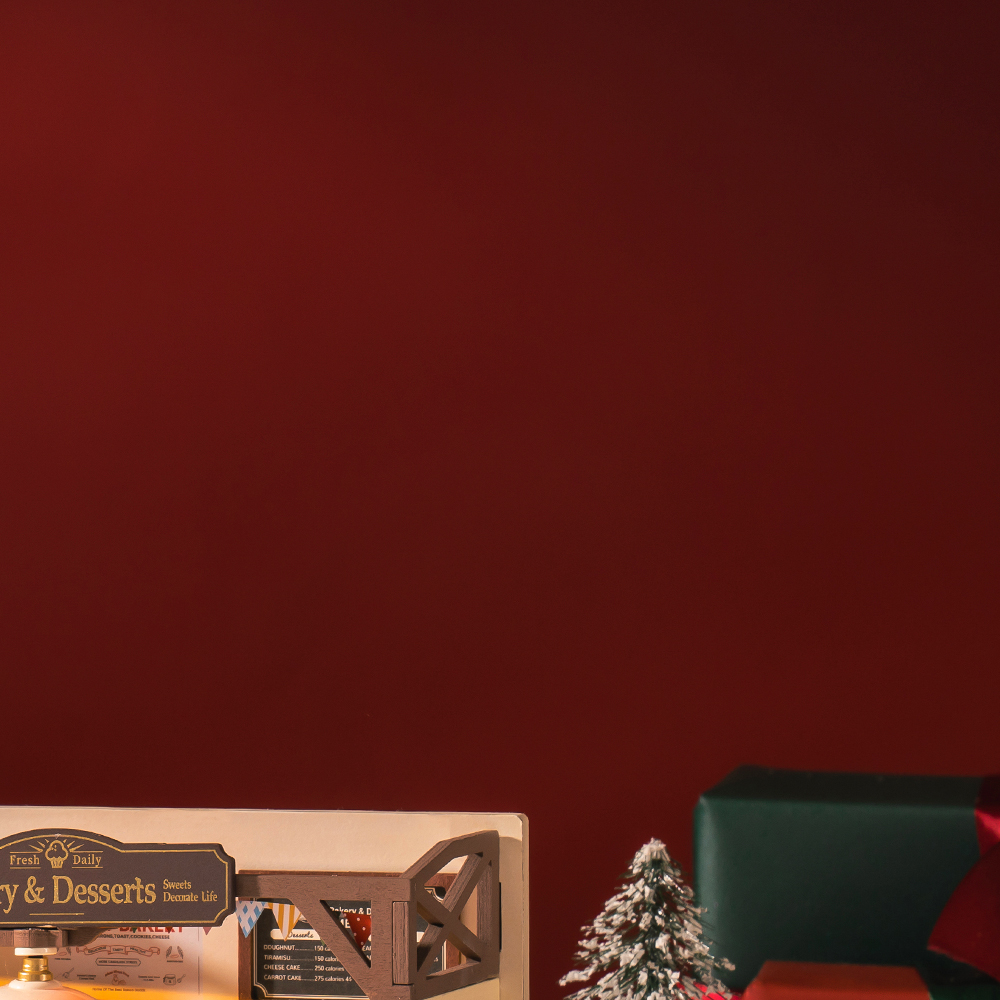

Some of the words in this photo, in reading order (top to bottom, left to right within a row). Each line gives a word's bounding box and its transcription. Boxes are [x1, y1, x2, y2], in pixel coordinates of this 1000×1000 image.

[10, 854, 41, 866] Fresh
[72, 854, 102, 868] Daily
[24, 876, 46, 904] &
[52, 875, 156, 905] Desserts
[163, 879, 192, 890] Sweets
[163, 891, 199, 902] Decorate
[201, 890, 218, 902] Life
